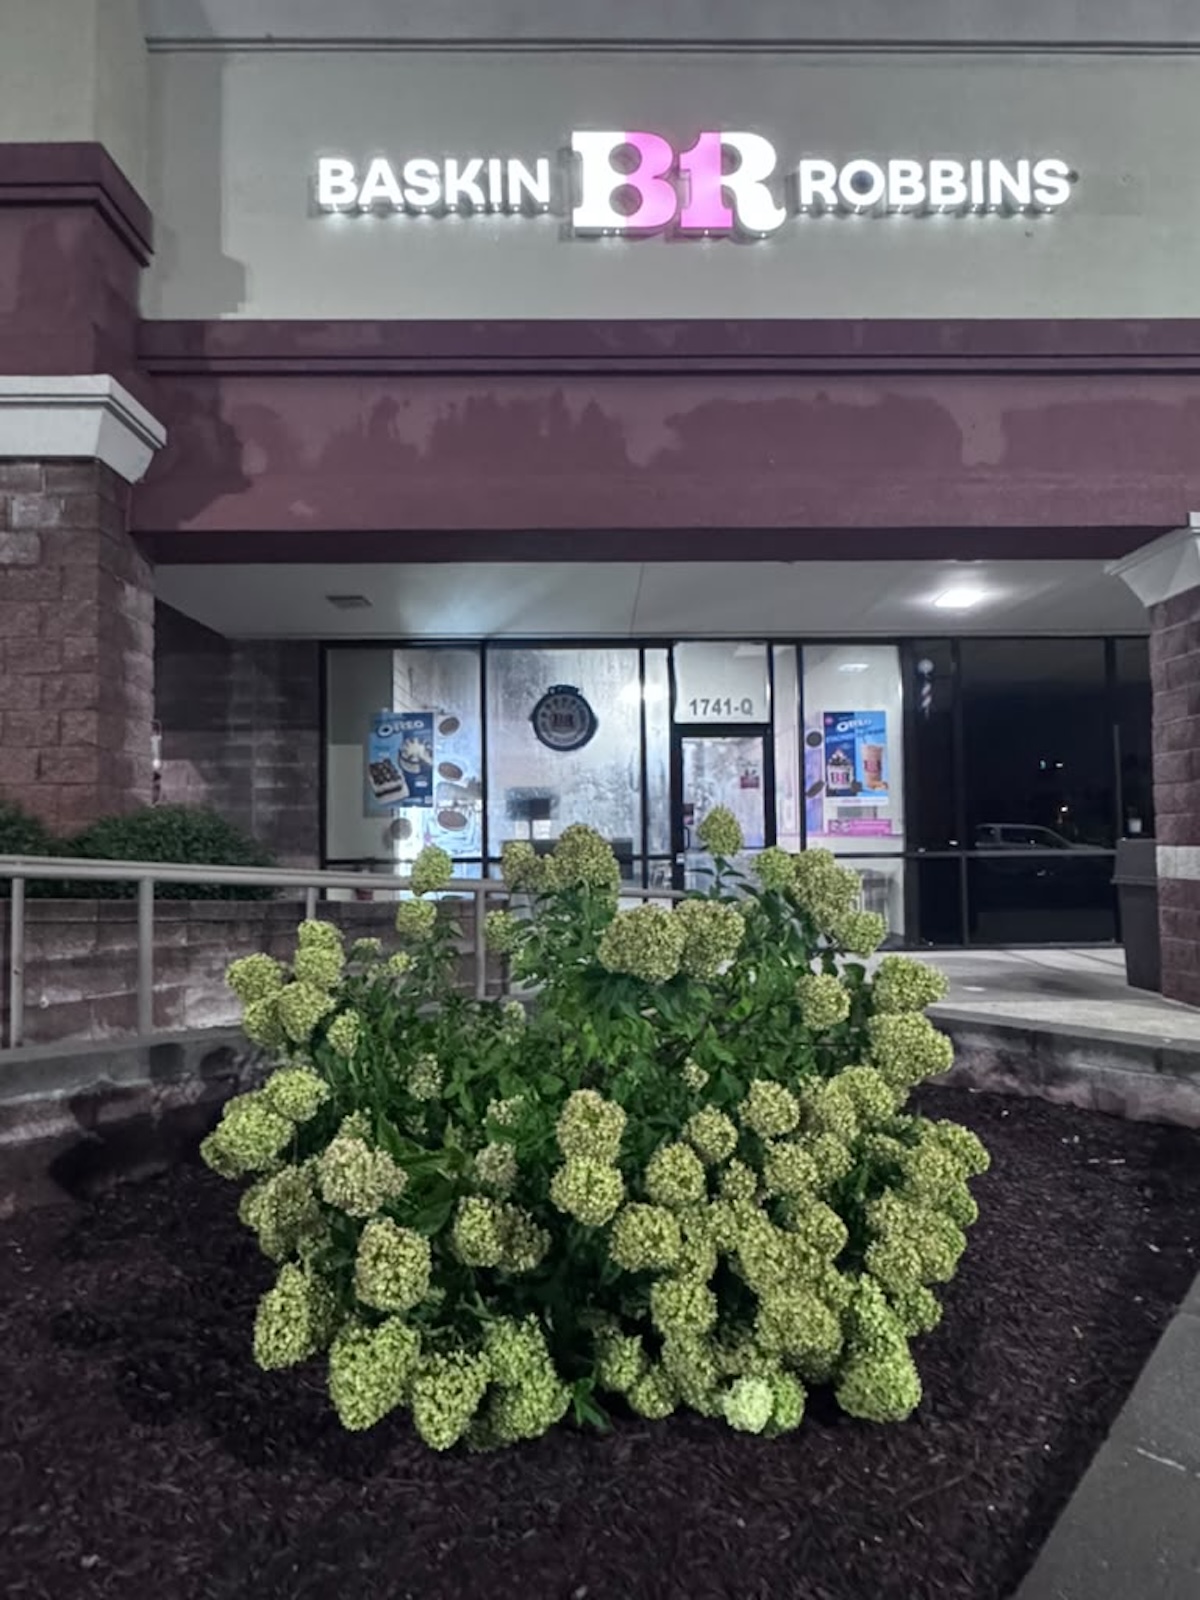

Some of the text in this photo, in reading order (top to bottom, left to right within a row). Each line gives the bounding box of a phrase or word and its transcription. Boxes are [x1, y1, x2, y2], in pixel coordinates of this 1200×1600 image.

[318, 157, 550, 206] BASKIN
[799, 158, 1071, 206] ROBBINS
[689, 697, 753, 717] 1741-Q
